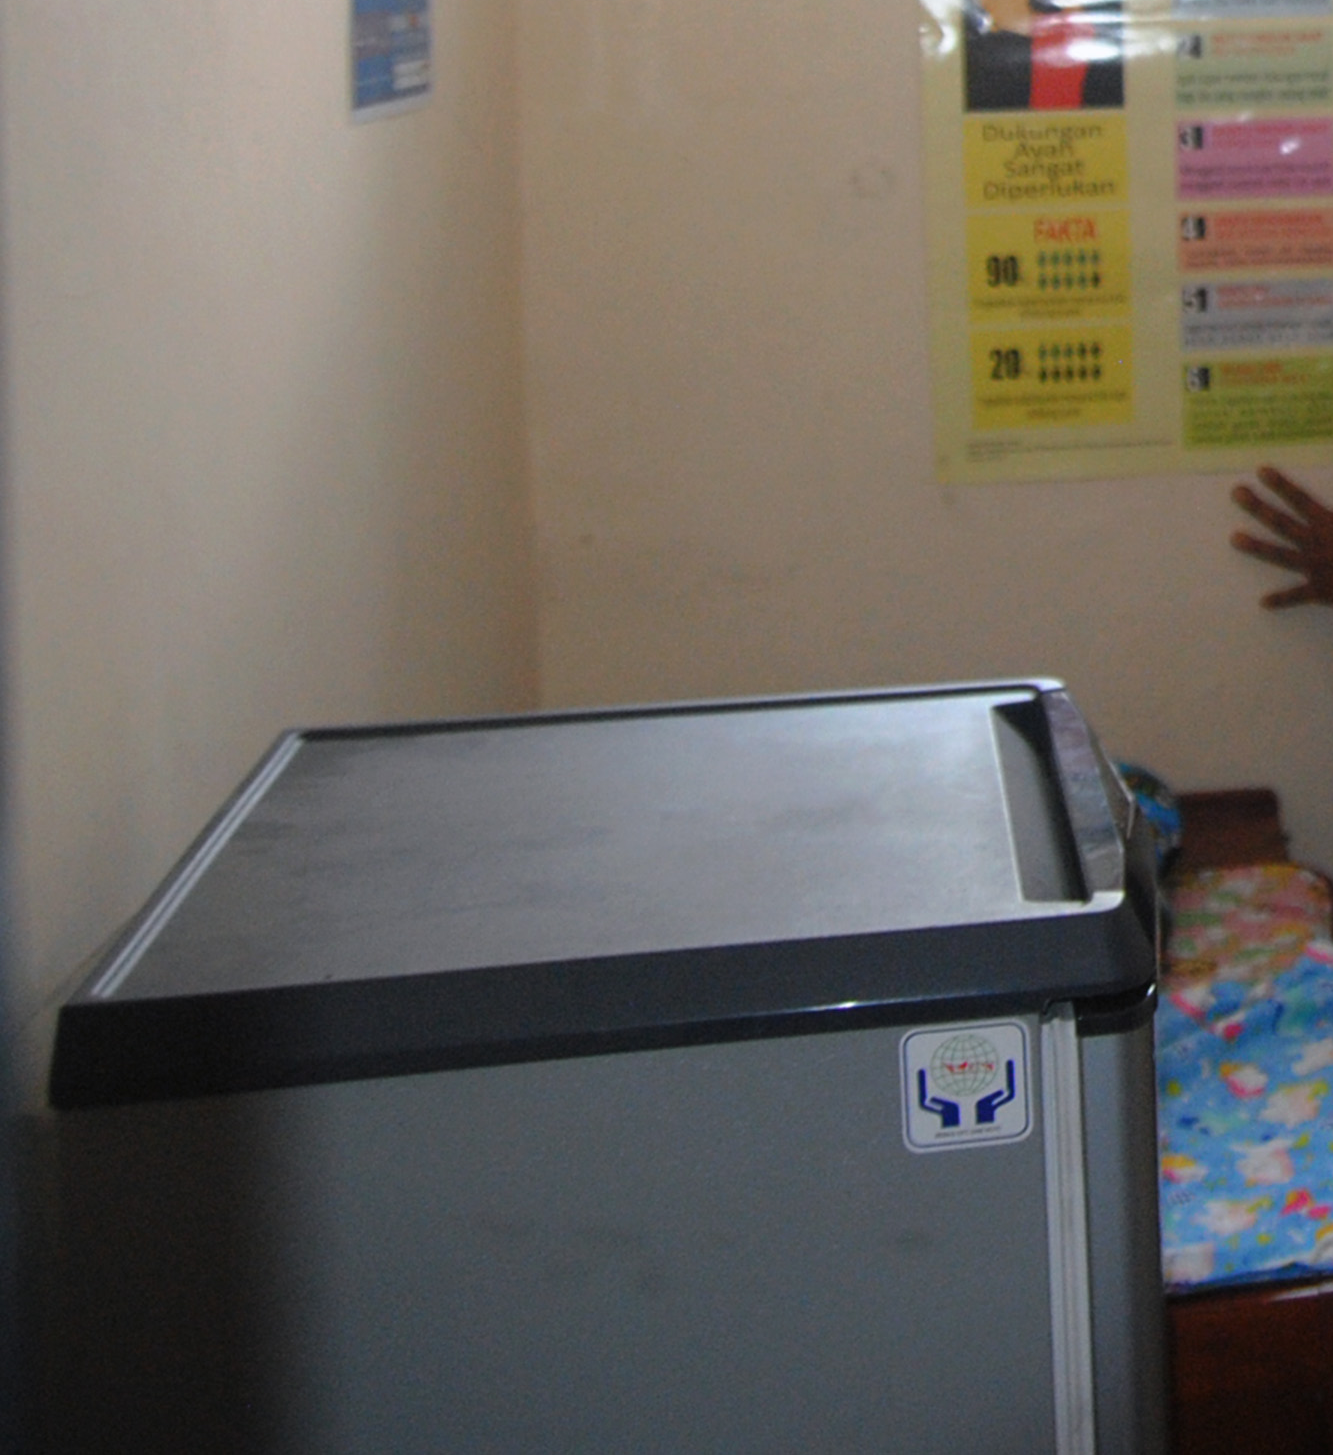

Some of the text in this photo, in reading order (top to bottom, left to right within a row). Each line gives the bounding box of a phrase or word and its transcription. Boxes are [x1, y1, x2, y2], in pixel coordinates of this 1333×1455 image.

[982, 124, 1102, 144] Dukungan
[1014, 142, 1074, 160] Ayah
[1004, 159, 1084, 180] Sangat
[983, 179, 1114, 201] Diperlukan
[1033, 217, 1097, 243] FAKTA
